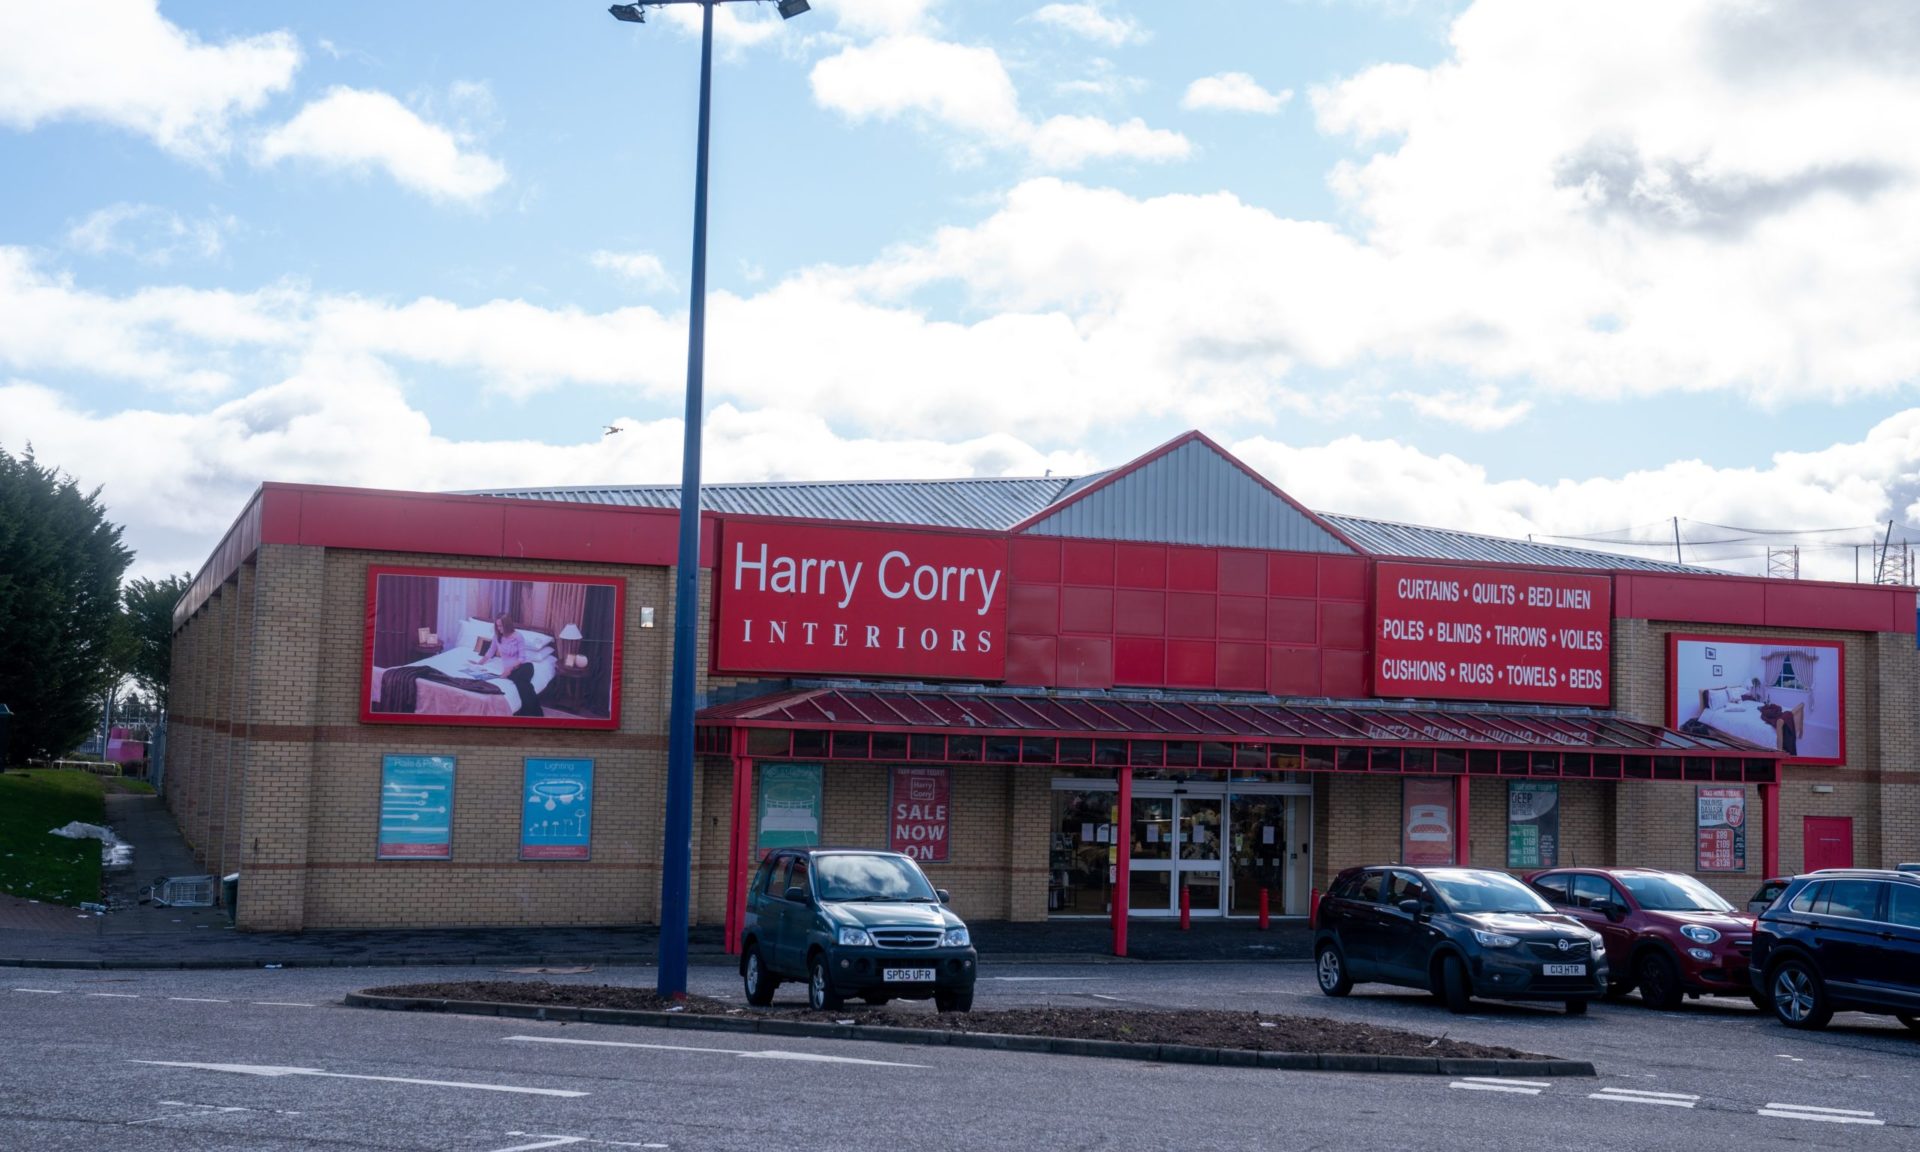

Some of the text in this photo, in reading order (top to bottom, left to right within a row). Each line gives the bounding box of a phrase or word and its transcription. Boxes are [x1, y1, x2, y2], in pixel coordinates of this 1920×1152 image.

[735, 542, 1000, 615] Harry Corry
[1398, 579, 1591, 609] CURTAINS QUILTS BED LINEN
[743, 619, 991, 652] INTERIORS
[1383, 619, 1603, 650] POLES BLINDS THROWS VOILES
[1382, 659, 1602, 689] CUSHIONS RUGS TOWELS BEDS
[544, 760, 575, 772] Lighting
[914, 780, 932, 790] Harry
[913, 790, 932, 799] Corry
[1511, 792, 1533, 803] DEEP
[896, 803, 946, 820] SALE
[896, 824, 945, 840] NOW
[904, 845, 934, 860] ON
[886, 970, 931, 980] SP05 UFR
[1564, 965, 1580, 974] HTR
